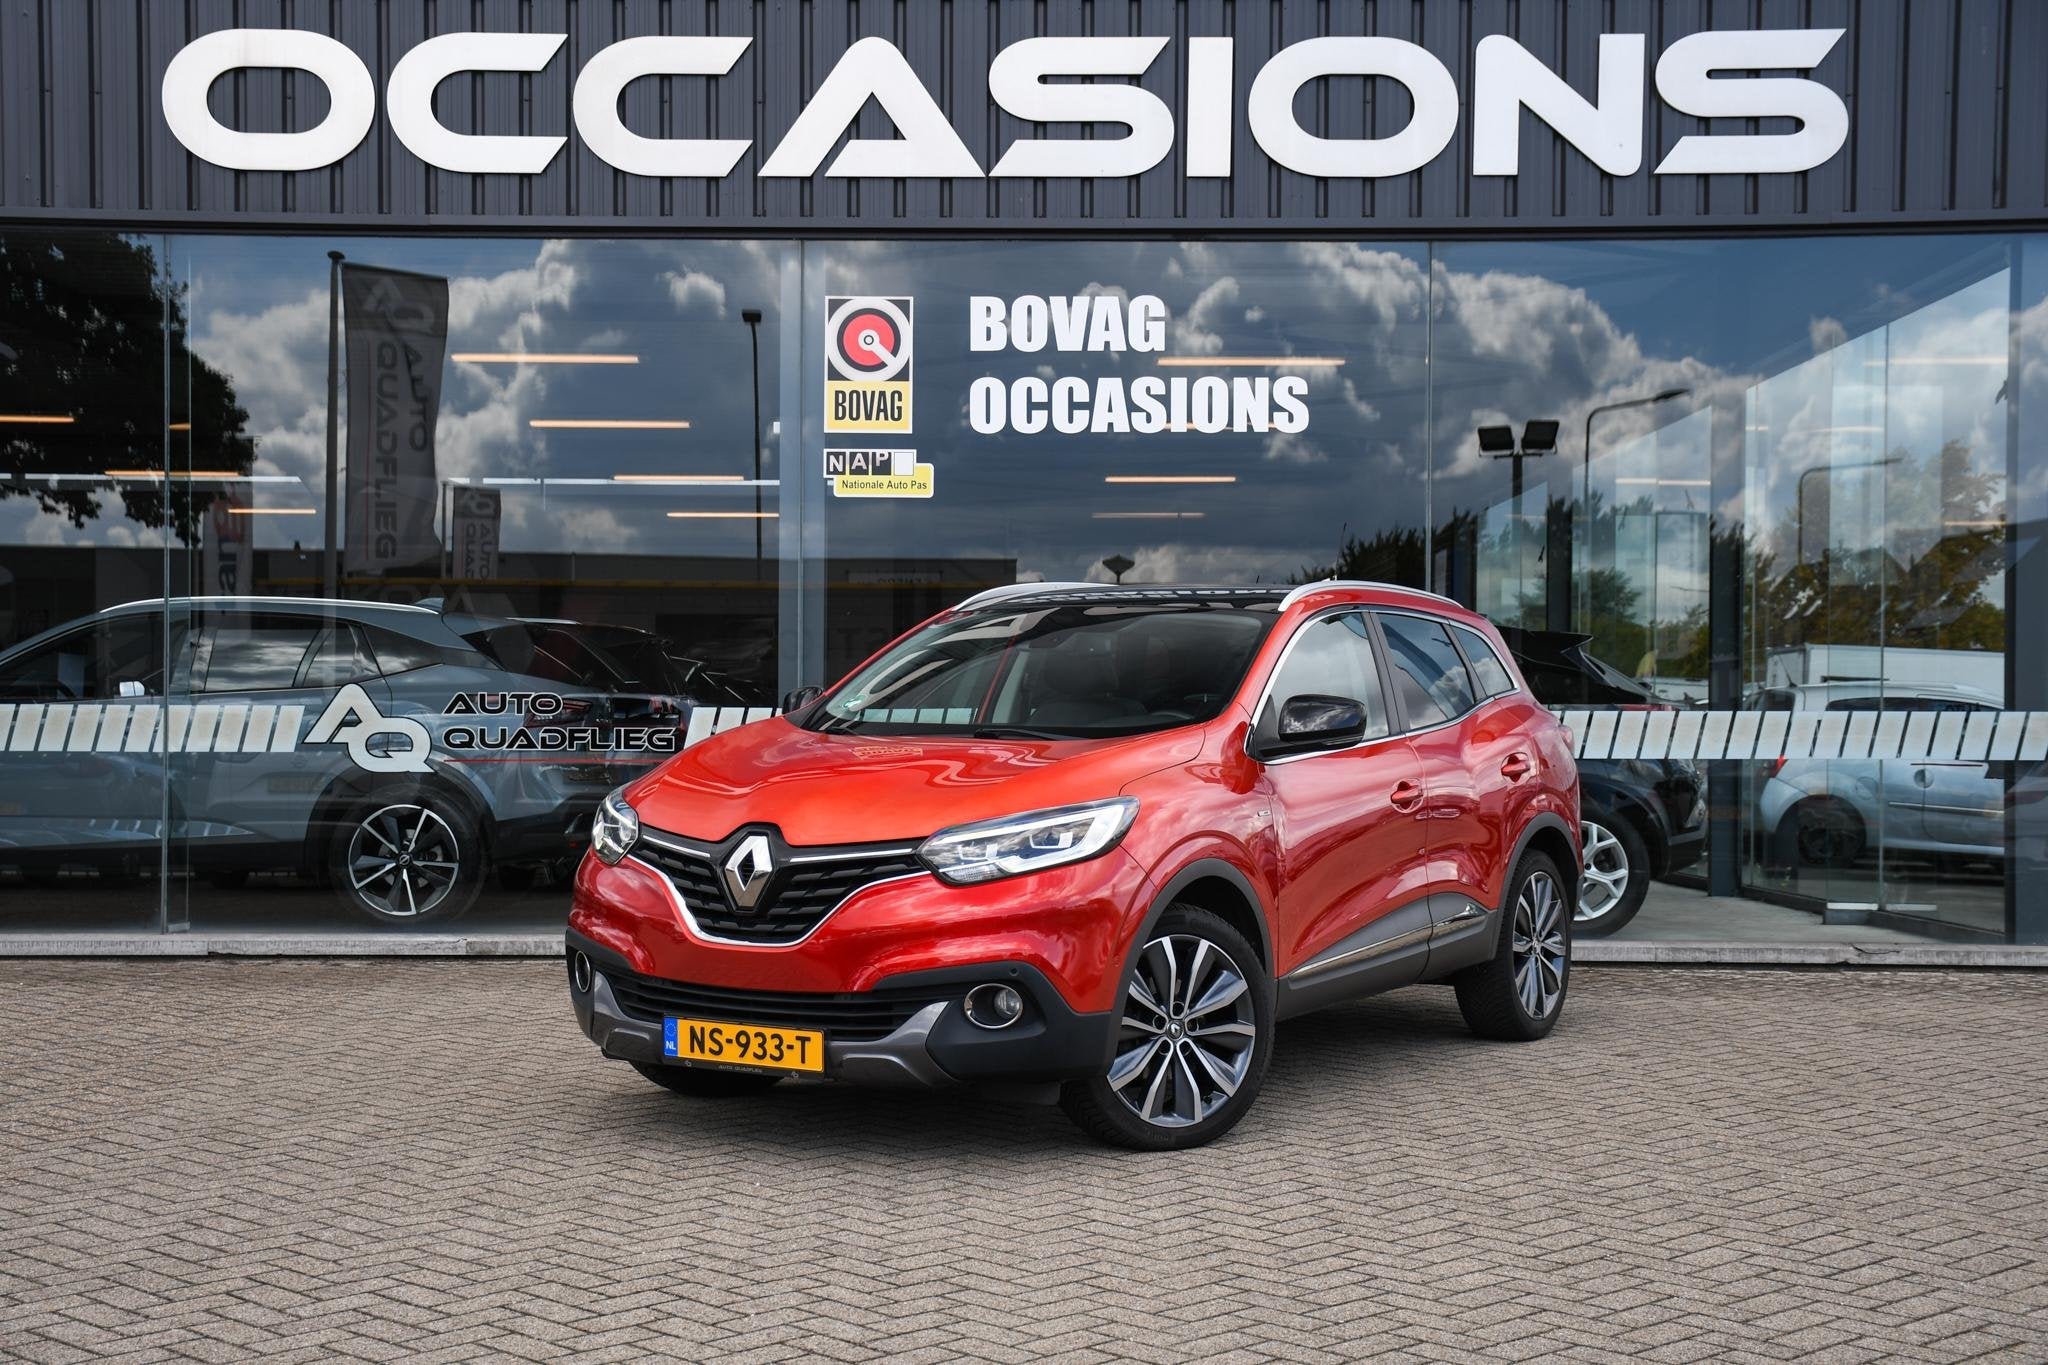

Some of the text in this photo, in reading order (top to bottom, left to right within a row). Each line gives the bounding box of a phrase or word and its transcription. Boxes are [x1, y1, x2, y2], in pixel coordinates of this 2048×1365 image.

[162, 28, 1849, 178] OCCASIONS
[970, 294, 1166, 352] BOVAG
[834, 389, 903, 422] BOVAG
[969, 376, 1310, 434] OCCASIONS
[829, 451, 889, 472] NAP
[842, 480, 927, 490] Nationale Auto Pas
[442, 692, 563, 716] AUTO
[442, 727, 676, 752] QUADFLIEG
[666, 1040, 676, 1050] NL
[689, 1025, 811, 1064] NS-933-T
